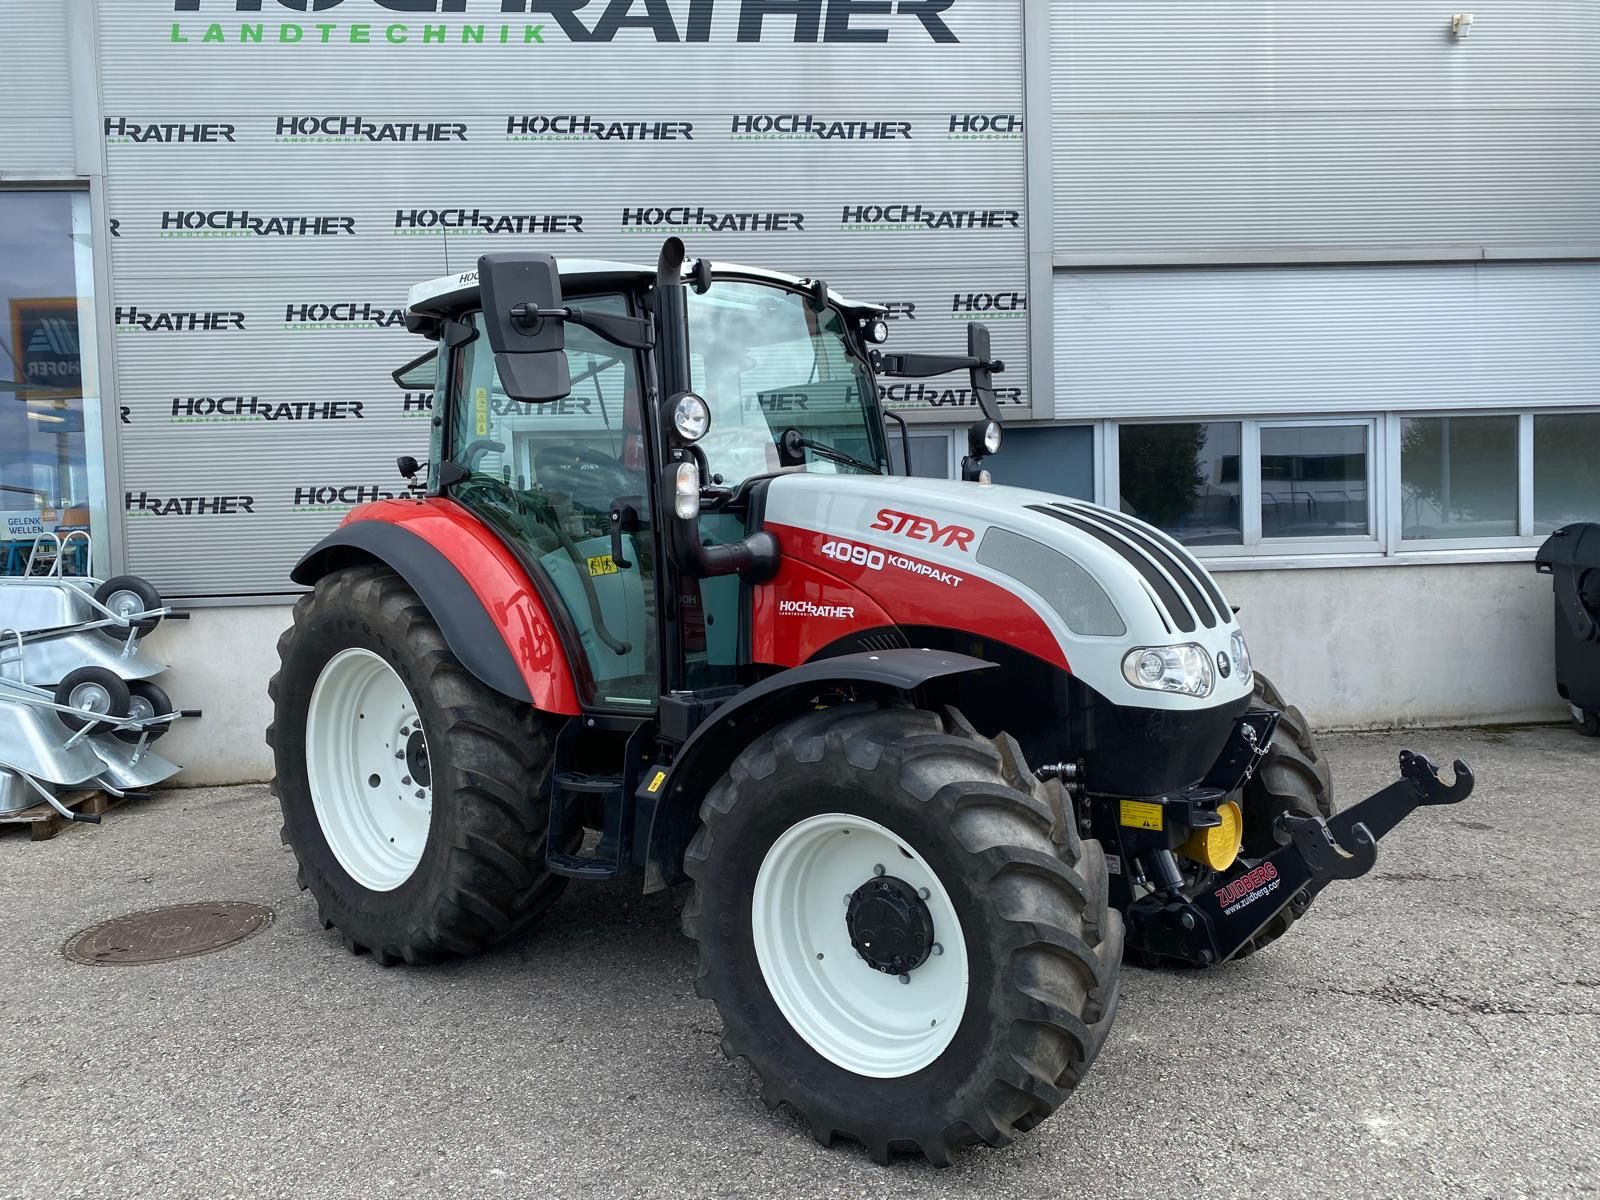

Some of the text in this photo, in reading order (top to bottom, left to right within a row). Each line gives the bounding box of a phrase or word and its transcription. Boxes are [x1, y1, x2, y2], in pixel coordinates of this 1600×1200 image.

[170, 23, 545, 43] LANDTECHNIK
[275, 116, 468, 142] HOCHRATHER
[505, 116, 694, 141] HOCHRATHER
[731, 114, 912, 139] HOCHRATHER
[161, 211, 356, 235] HOCHRATHER
[395, 209, 584, 233] HOCHRATHER
[621, 207, 805, 231] HOCHRATHER
[841, 205, 1020, 228] HOCHRATHER
[172, 397, 364, 421] HOCHRATHER
[8, 517, 41, 526] GELENK
[9, 526, 44, 534] WELLEN
[869, 508, 976, 553] STEYR
[821, 540, 963, 587] 4090 KOMPAKT
[779, 600, 855, 619] HOCHRATHER
[1215, 861, 1278, 908] ZUIDBERG
